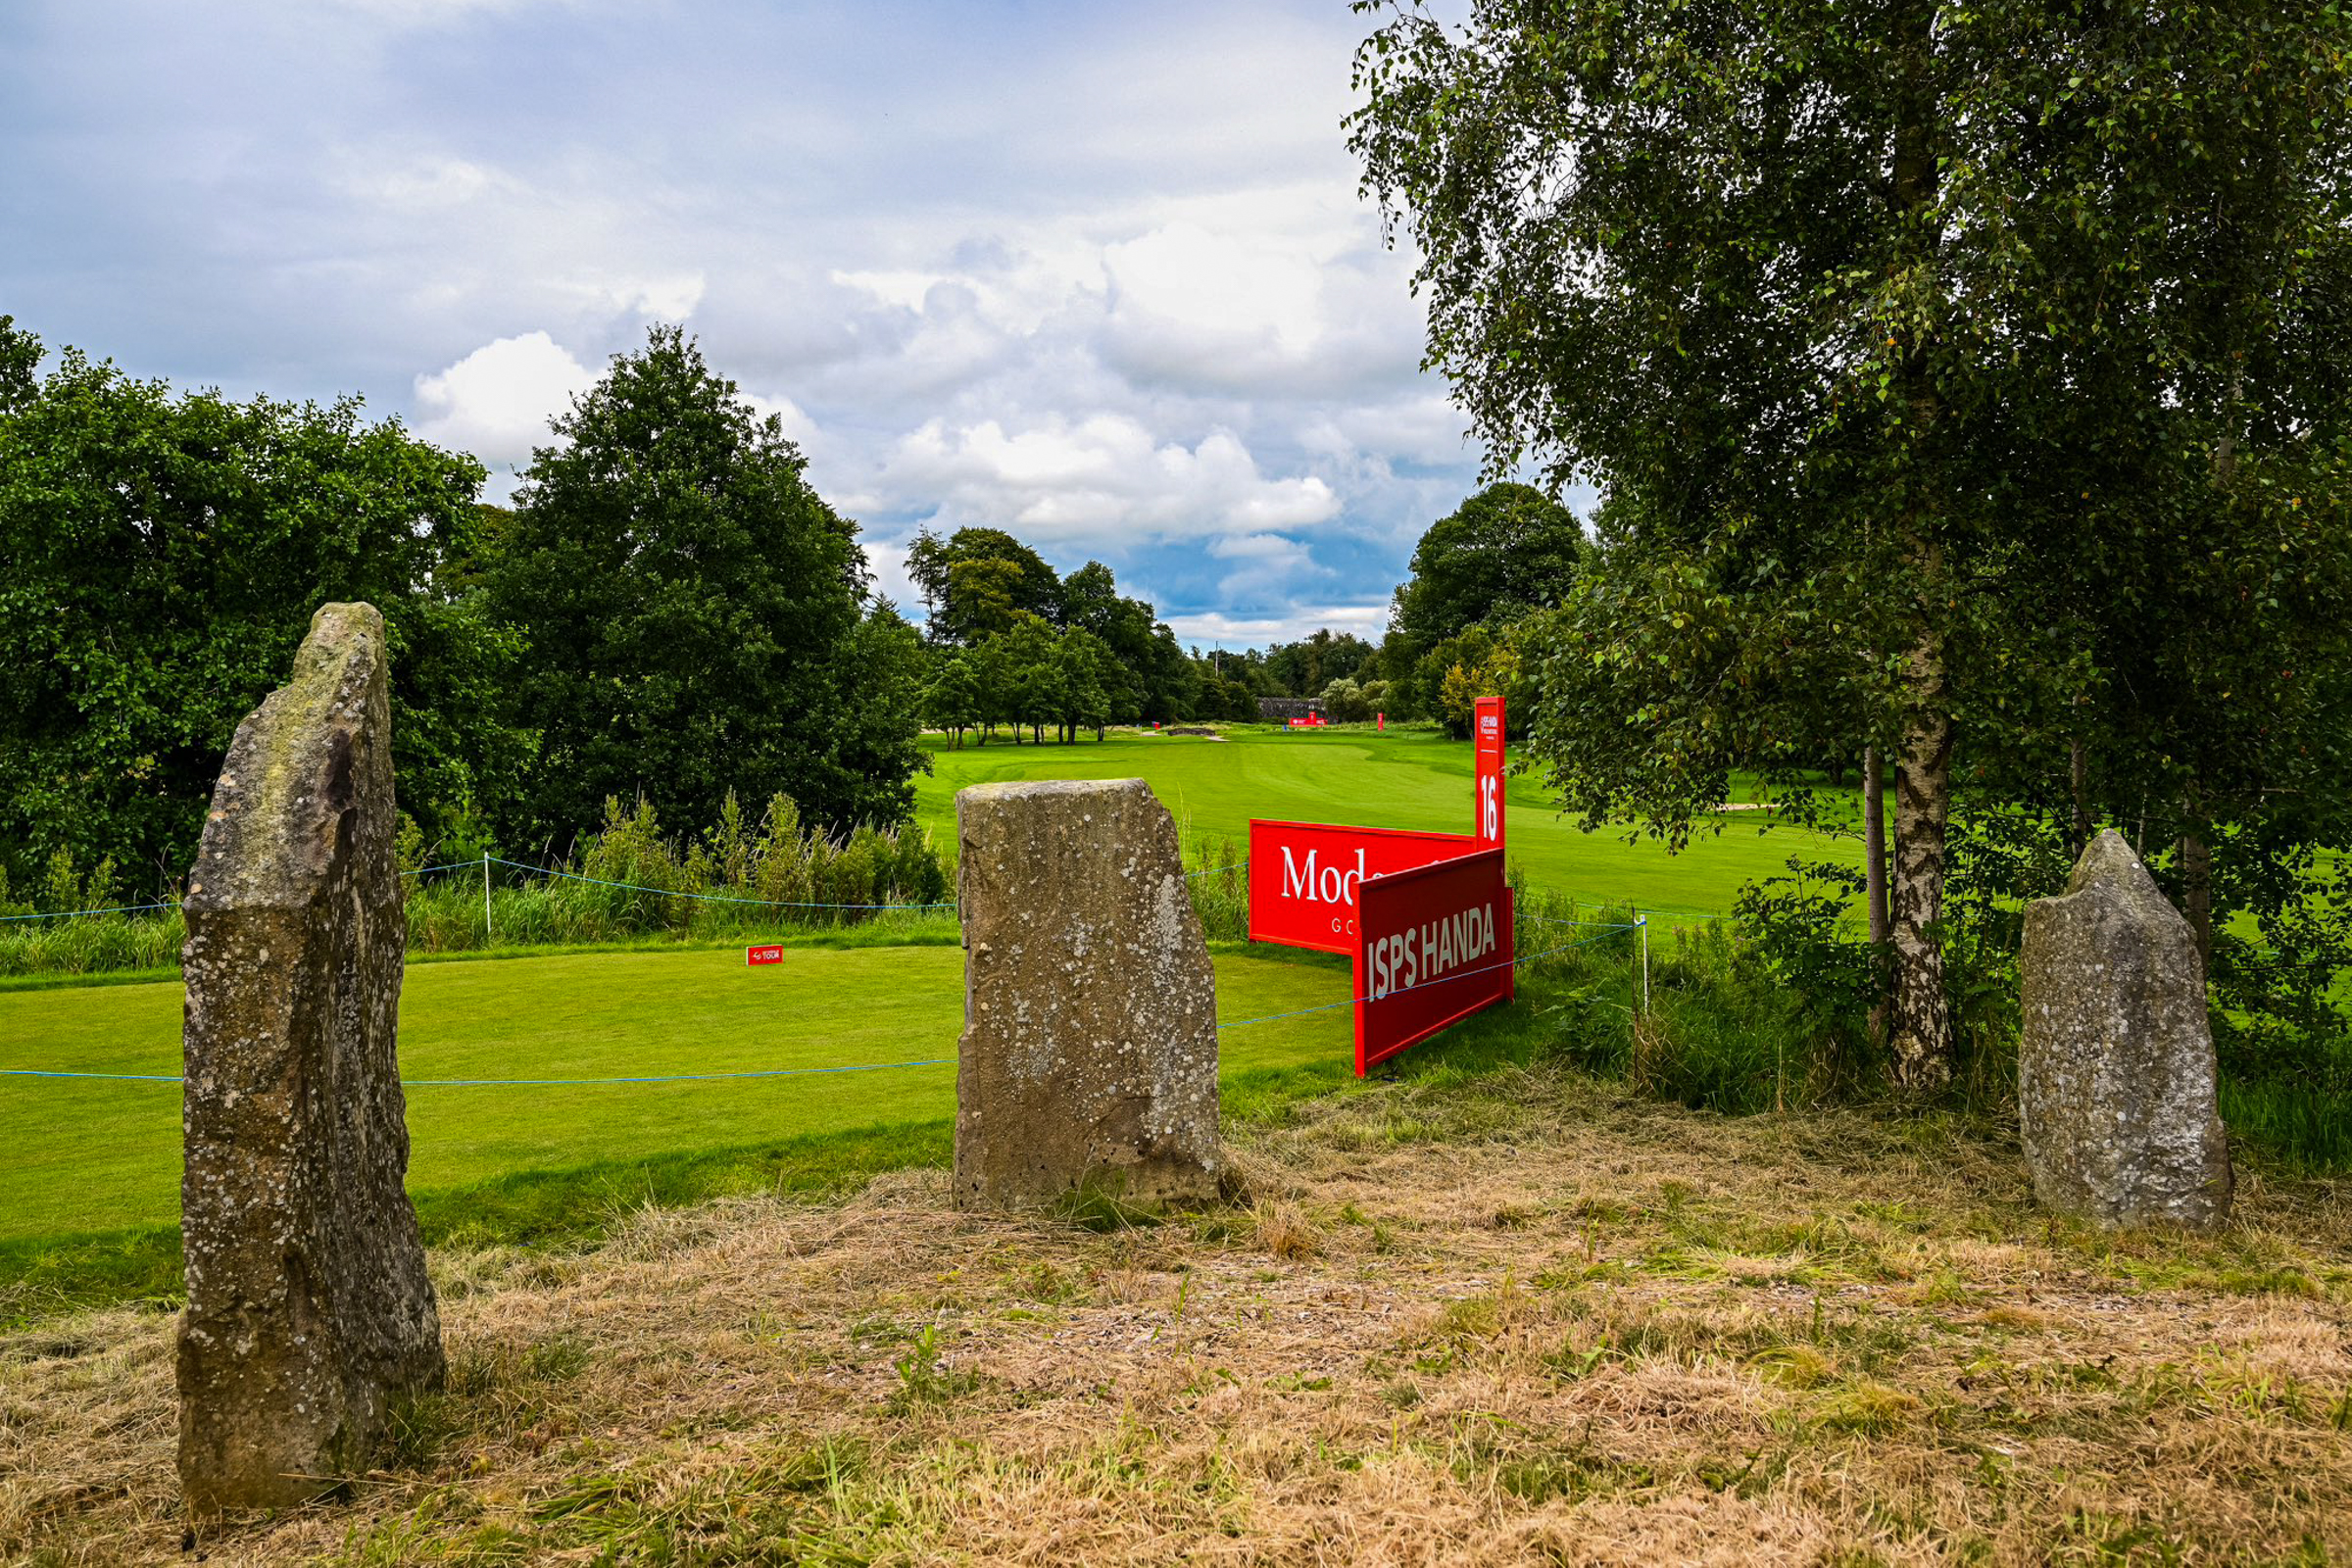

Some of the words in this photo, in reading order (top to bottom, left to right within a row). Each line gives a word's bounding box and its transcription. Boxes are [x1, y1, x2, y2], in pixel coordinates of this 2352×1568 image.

[1481, 775, 1497, 841] 16
[1281, 846, 1384, 906] Mod
[1368, 927, 1417, 1003] ISPS
[1422, 903, 1495, 980] HANDA
